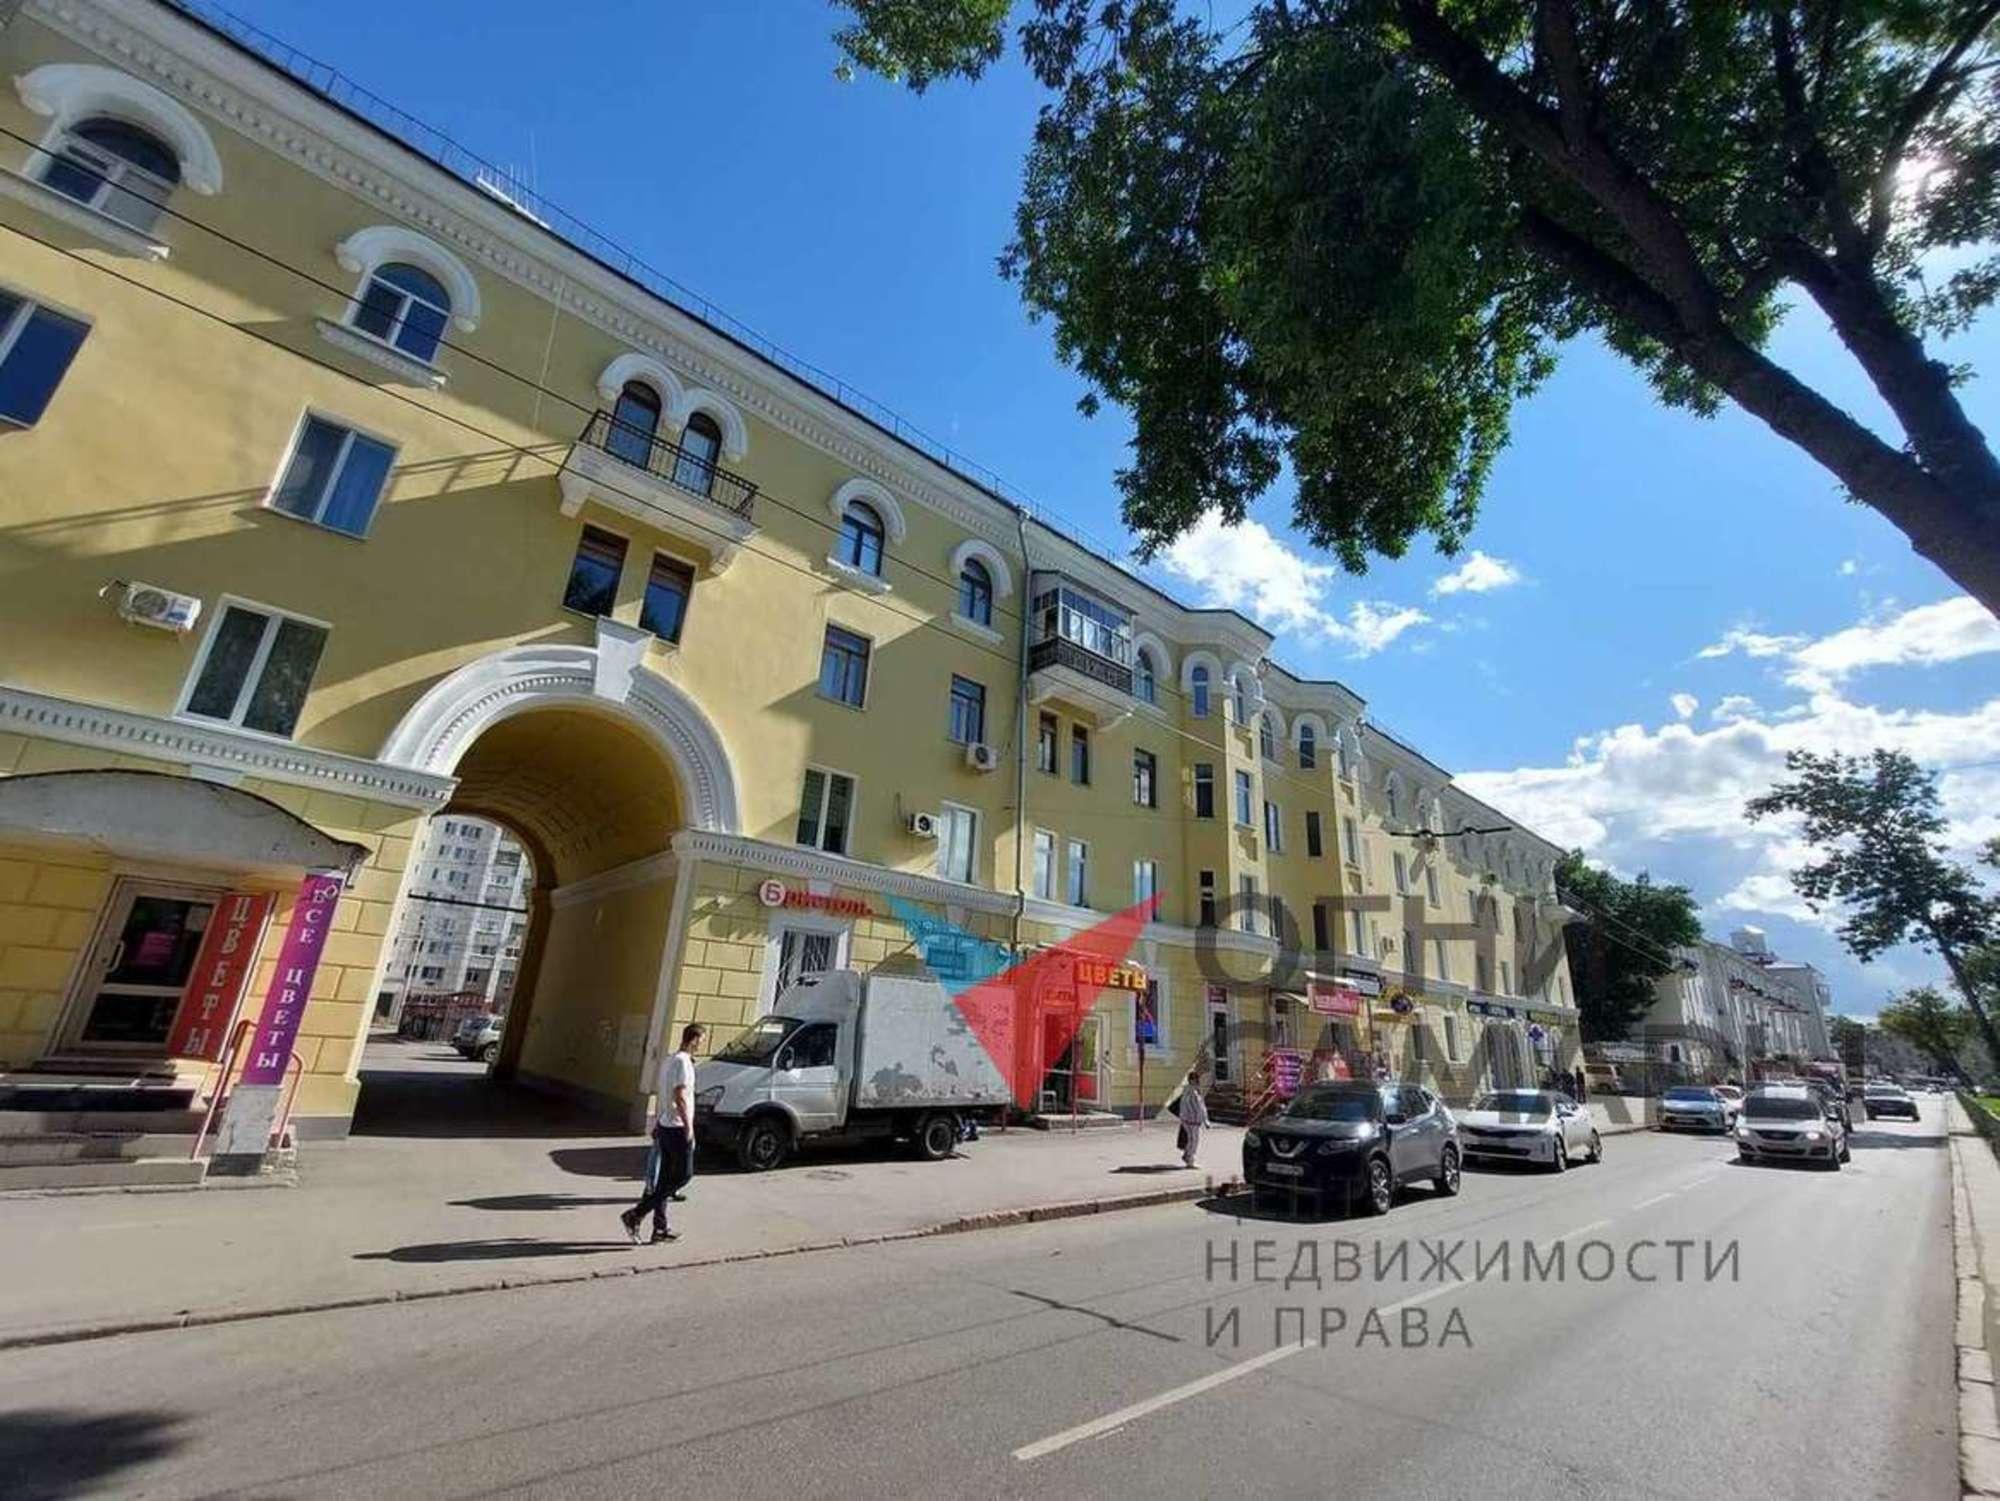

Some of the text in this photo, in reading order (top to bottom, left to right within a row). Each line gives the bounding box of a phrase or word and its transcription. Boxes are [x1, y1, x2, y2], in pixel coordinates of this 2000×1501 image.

[182, 896, 252, 1055] ЦВЕТЫ
[256, 888, 326, 1069] ВСЕ ЦВЕТЫ
[1078, 961, 1147, 990] ЦВЕТЫ
